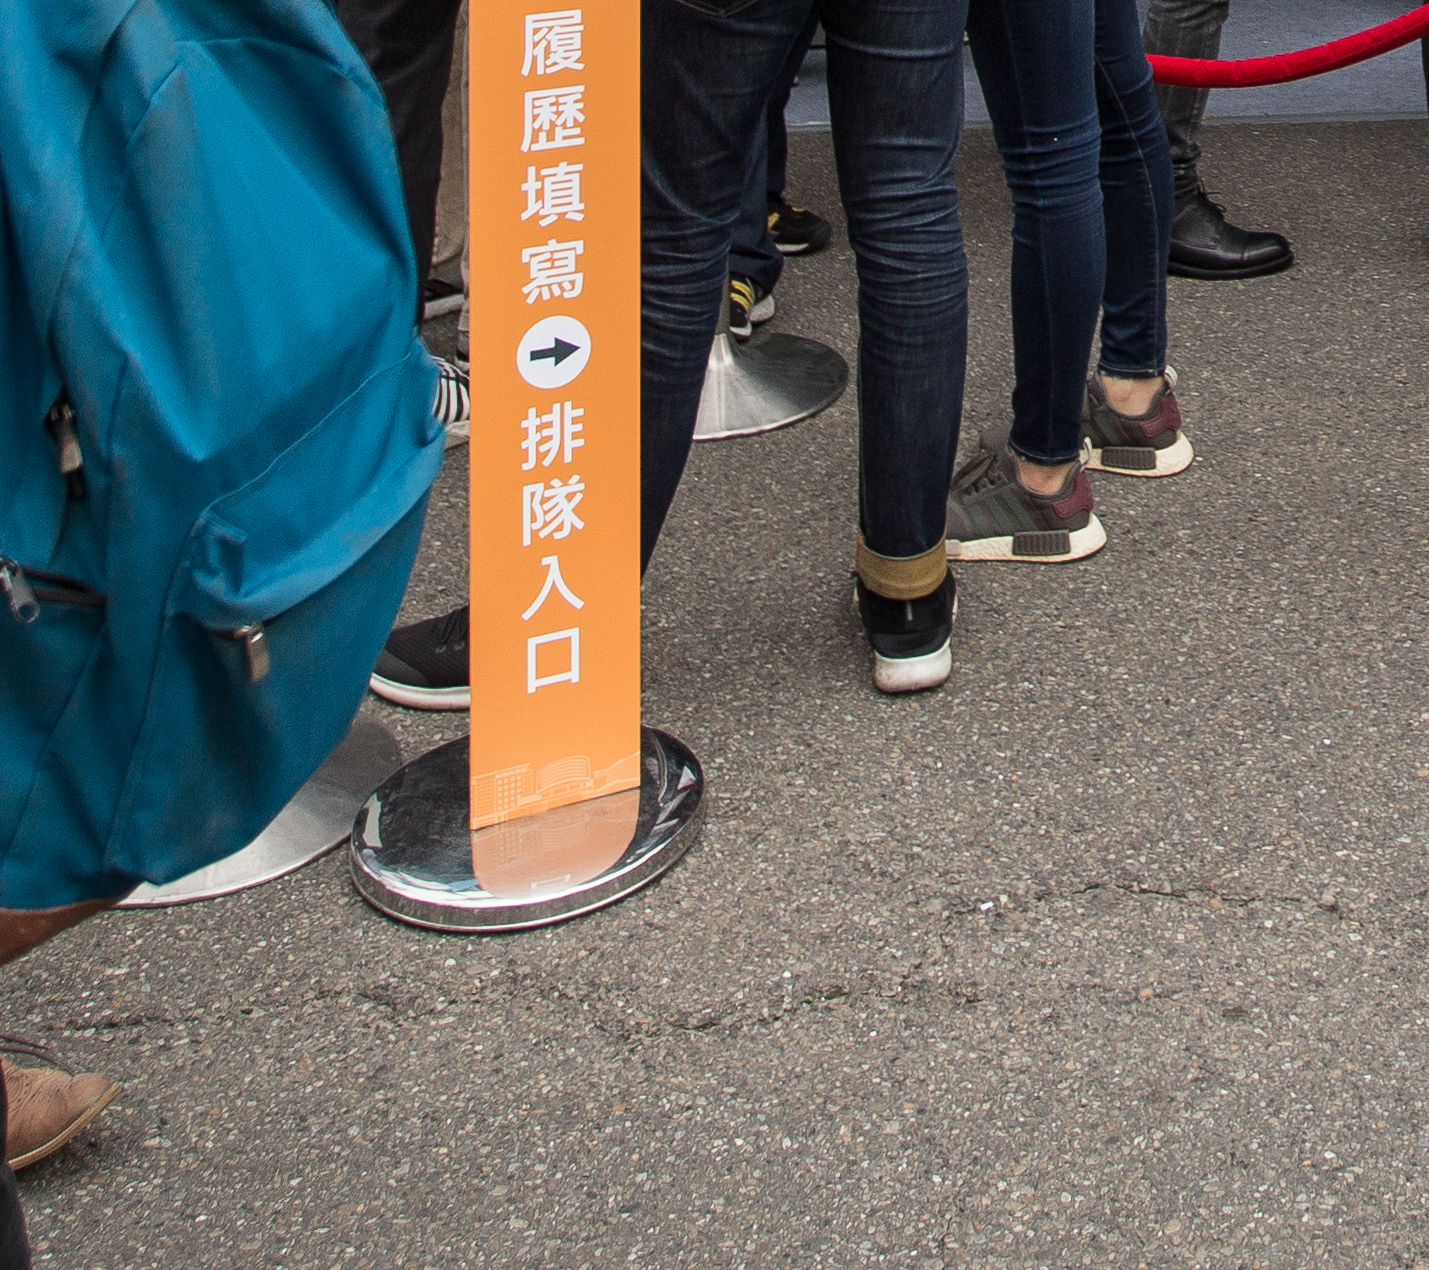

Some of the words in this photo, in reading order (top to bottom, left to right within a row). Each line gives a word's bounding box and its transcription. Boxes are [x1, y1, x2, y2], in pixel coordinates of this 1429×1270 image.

[520, 9, 586, 307] 履歷填寫
[520, 400, 586, 695] 排隊入口
